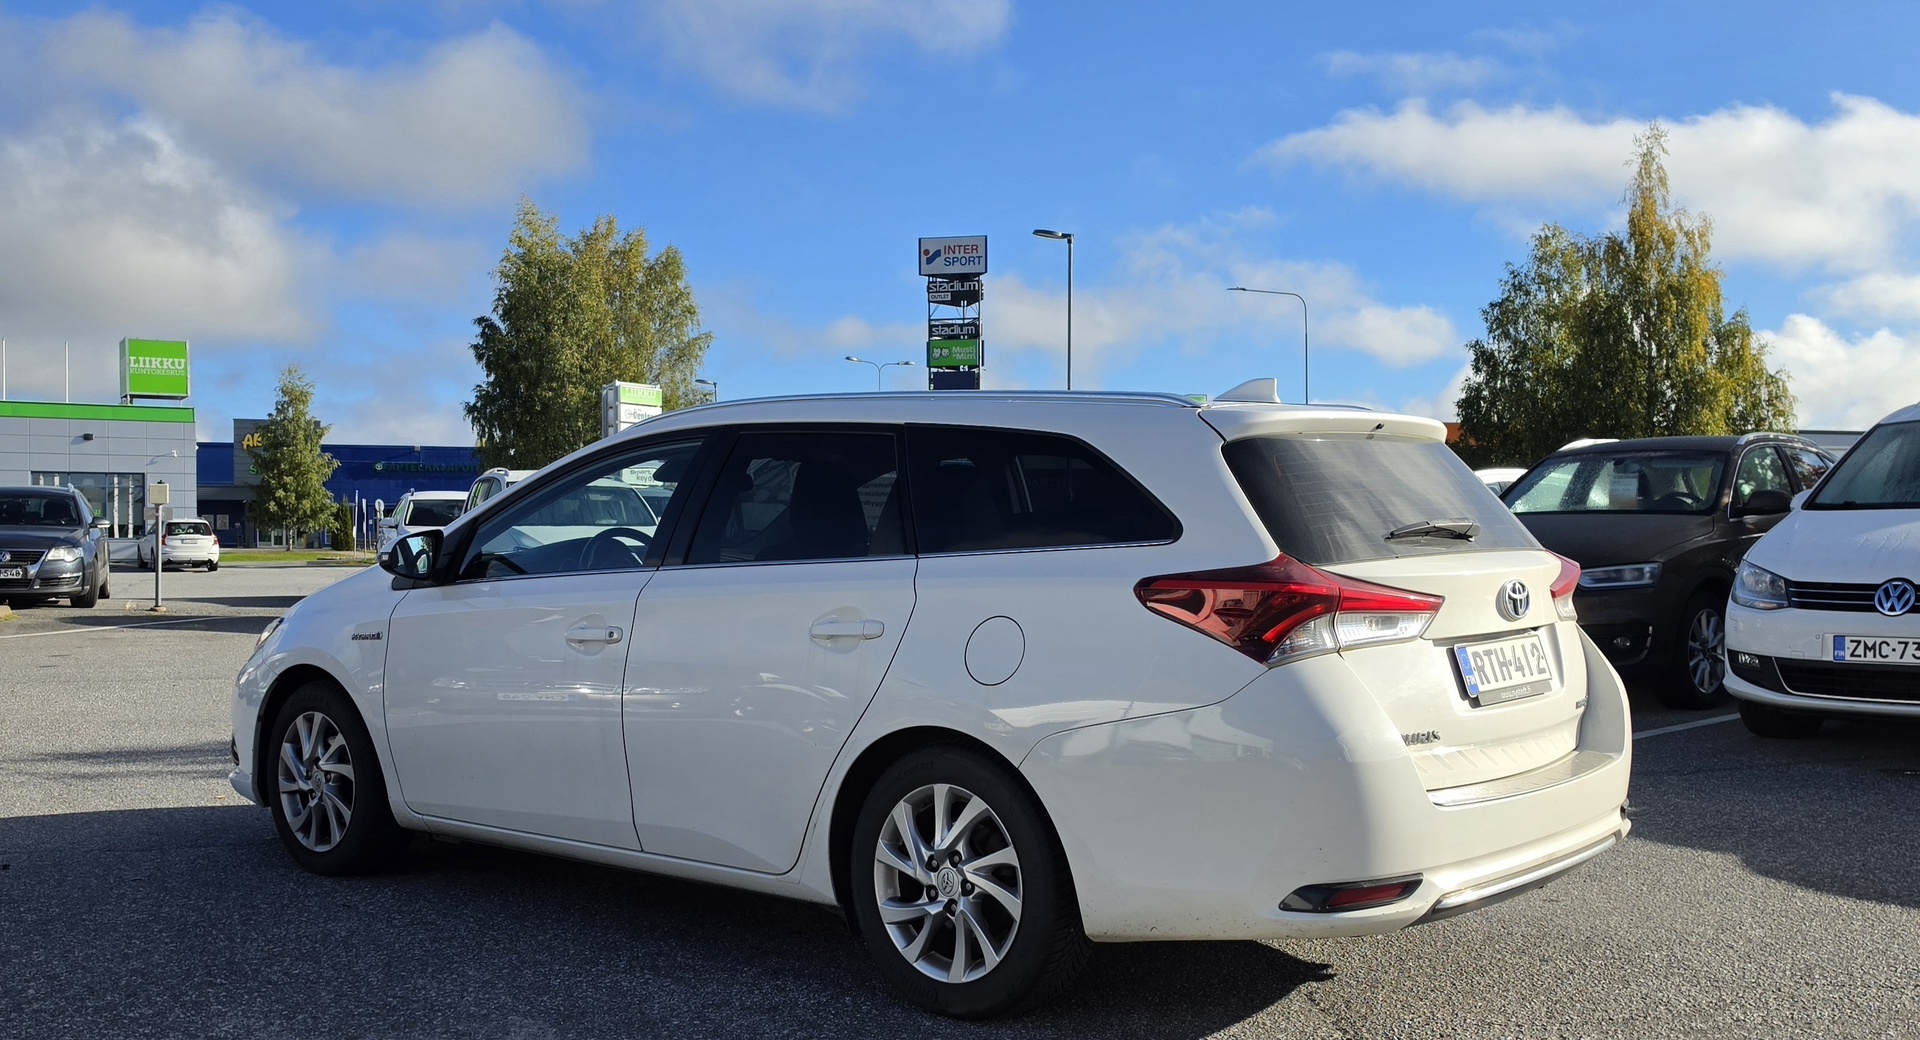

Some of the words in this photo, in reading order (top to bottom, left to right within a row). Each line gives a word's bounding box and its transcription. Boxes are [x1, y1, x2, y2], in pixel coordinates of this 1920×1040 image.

[943, 244, 979, 255] INTER
[943, 255, 983, 267] SPORT
[929, 280, 979, 292] stadium
[931, 325, 976, 335] stadium
[952, 345, 977, 353] Musti
[129, 356, 186, 370] LIIKKU
[129, 367, 186, 376] KUNTOKESKUS
[625, 387, 657, 399] LIIKKU
[1834, 649, 1845, 657] FIN
[1470, 642, 1547, 686] RTH-412
